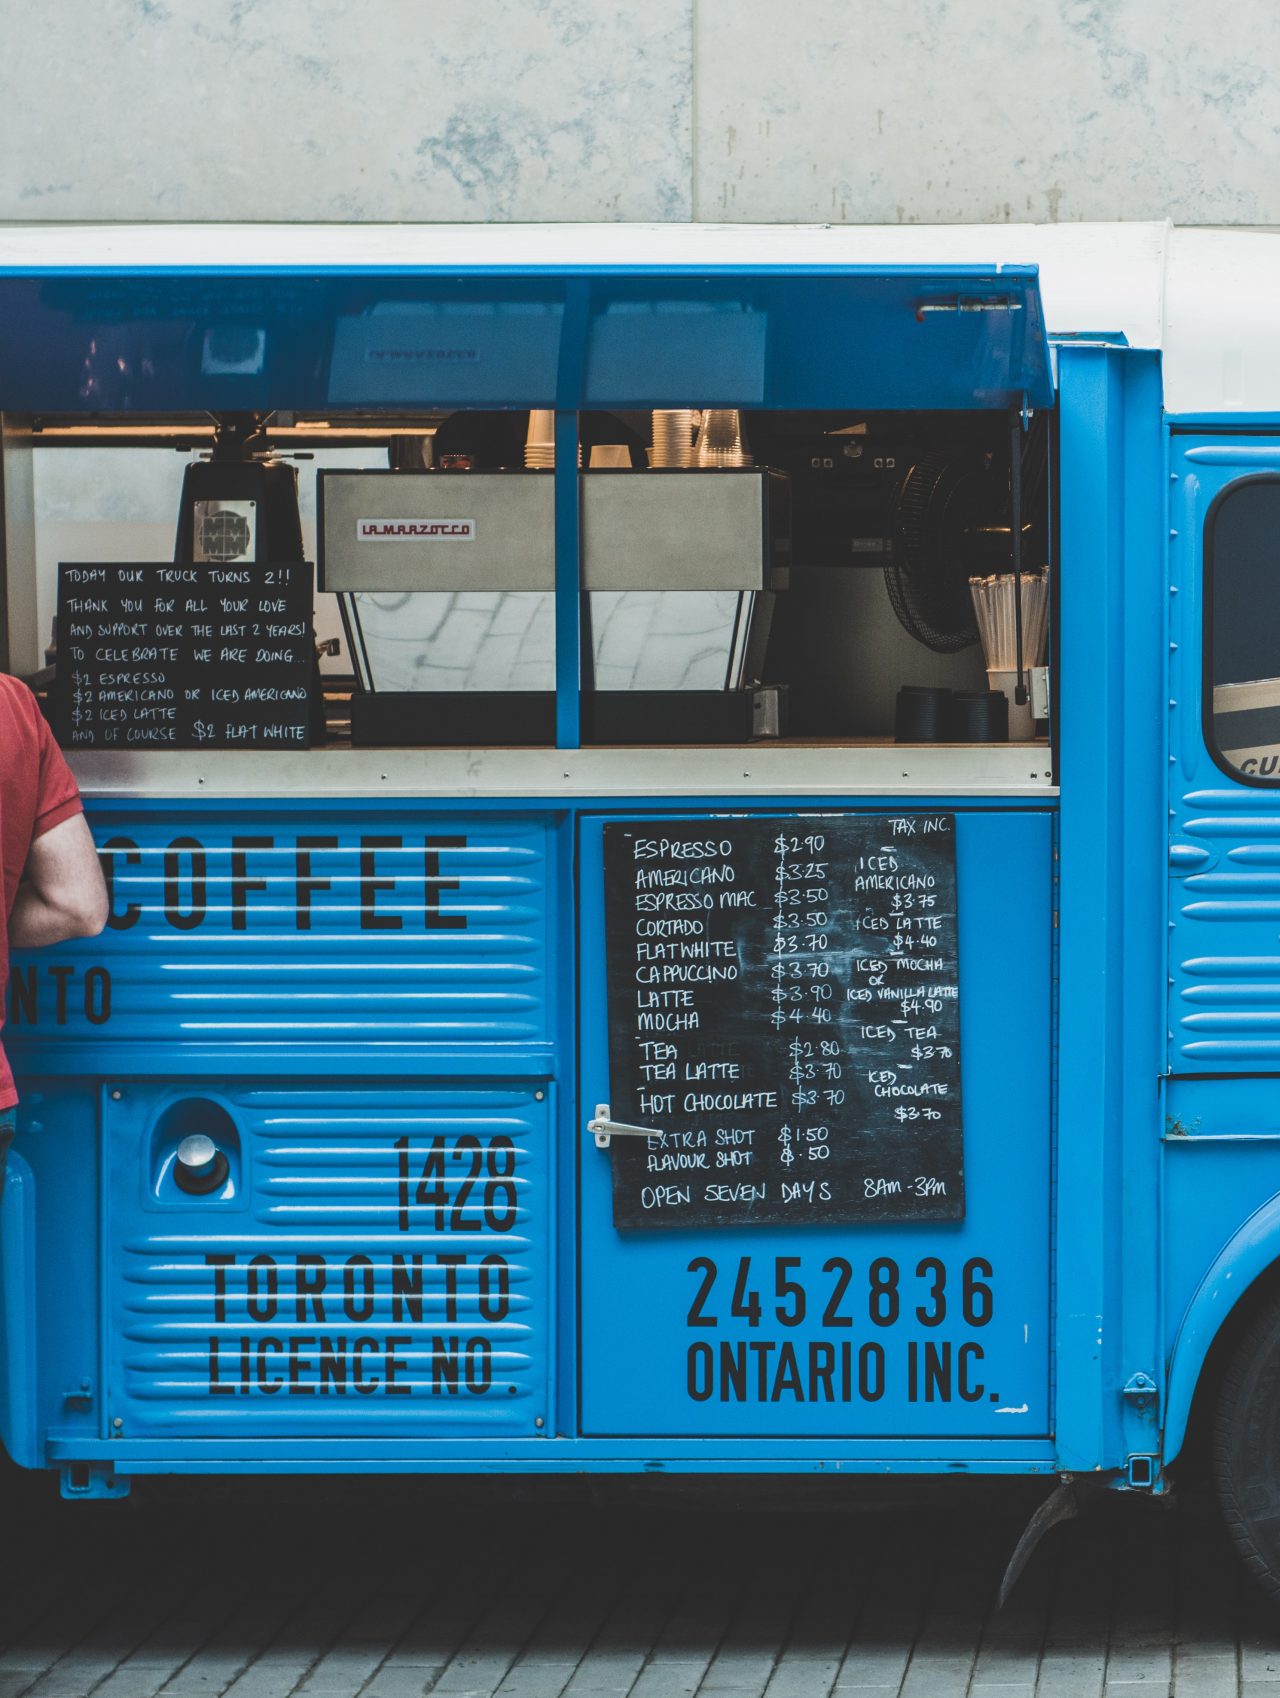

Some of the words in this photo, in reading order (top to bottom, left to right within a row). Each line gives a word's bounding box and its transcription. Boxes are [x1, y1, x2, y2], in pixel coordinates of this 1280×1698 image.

[363, 525, 377, 534] LA
[65, 569, 106, 582] TODAY
[118, 571, 144, 582] OUR
[156, 569, 198, 583] TRUCK
[208, 570, 250, 583] TURNS
[264, 569, 290, 586] 2!!
[67, 600, 108, 613] THANK
[121, 601, 143, 613] YOU
[154, 599, 174, 613] FOR
[185, 600, 207, 612] ALL
[220, 601, 249, 613] YOUR
[259, 601, 286, 612] LOVE
[70, 624, 92, 638] AND
[98, 623, 148, 637] SUPPORT
[155, 624, 183, 637] OVER
[191, 624, 212, 636] THE
[220, 623, 244, 637] LAST
[253, 624, 260, 636] 2
[266, 622, 306, 638] YEARS!
[69, 646, 84, 661] TO
[96, 648, 178, 663] CELEBRATE
[193, 650, 211, 662] WE
[220, 649, 246, 662] ARE
[72, 670, 92, 687] $2
[99, 673, 165, 685] ESPRESSO
[73, 688, 92, 705] $2
[99, 690, 174, 701] AMERICANO
[184, 689, 200, 700] OR
[211, 689, 239, 703] ICED
[245, 688, 307, 701] AMERICANO
[72, 707, 92, 725] $2
[100, 708, 126, 722] ICED
[133, 708, 176, 720] LATTE
[72, 731, 95, 742] AND
[105, 728, 118, 741] OF
[127, 728, 176, 741] COURSE
[192, 721, 216, 740] $2
[225, 724, 258, 740] FLAT
[263, 725, 304, 740] WHITE
[888, 818, 916, 836] TAX
[924, 818, 951, 834] INC.
[634, 839, 732, 859] ESPRESSO
[774, 833, 825, 860] $2.90
[860, 856, 898, 872] ICED
[101, 835, 468, 931] COFFEE
[635, 864, 735, 889] AMERICANO
[775, 860, 829, 886] $3.25
[855, 874, 935, 892] AMERICANO
[635, 893, 714, 911] ESPRESSO
[720, 891, 757, 909] MAC
[774, 886, 828, 908] $3.50
[891, 893, 937, 910] $3.75
[636, 919, 703, 937] CORTADO
[773, 910, 827, 930] $3.50
[856, 916, 889, 930] ICED
[896, 916, 942, 930] LATTE
[774, 932, 827, 959] $3.70
[893, 932, 937, 950] $4.40
[636, 964, 737, 984] CAPPUCCINO
[771, 962, 829, 982] $3.70
[856, 959, 888, 973] ICED
[896, 958, 943, 971] MOCHA
[869, 974, 884, 985] OR
[10, 965, 112, 1025] NTO
[637, 990, 694, 1008] LATTE
[771, 983, 832, 1004] $3.90
[847, 988, 872, 1002] ICED
[878, 985, 925, 1000] VANILLA
[928, 987, 958, 997] LATTE
[901, 999, 942, 1017] $4.90
[638, 1012, 699, 1031] MOCHA
[771, 1006, 831, 1030] $4.40
[861, 1025, 896, 1042] ICED
[904, 1026, 938, 1039] TEA
[639, 1041, 677, 1060] TEA
[789, 1036, 840, 1064] $2.80
[639, 1065, 676, 1080] TEA
[686, 1063, 739, 1080] LATTE
[789, 1061, 842, 1085] $3.70
[868, 1070, 896, 1086] ICED
[640, 1093, 675, 1114] HOT
[684, 1091, 778, 1112] CHOCOLATE
[792, 1085, 845, 1113] $3.70
[875, 1083, 948, 1097] CHOCOLATE
[894, 1105, 941, 1123] $3.70
[647, 1131, 707, 1150] EXTRA
[715, 1129, 756, 1145] SHOT
[778, 1124, 829, 1146] $1.50
[647, 1153, 711, 1172] FLAVOUR
[716, 1150, 754, 1167] SHOT
[393, 1134, 518, 1232] 1428
[641, 1185, 690, 1209] OPEN
[704, 1183, 766, 1201] SEVEN
[782, 1180, 832, 1202] DAYS
[205, 1253, 510, 1324] TORONTO
[687, 1256, 994, 1328] 2452836
[208, 1335, 412, 1395] LICENCE
[430, 1335, 518, 1395] NO.
[687, 1341, 885, 1402] ONTARIO
[908, 1341, 1000, 1402] INC.
